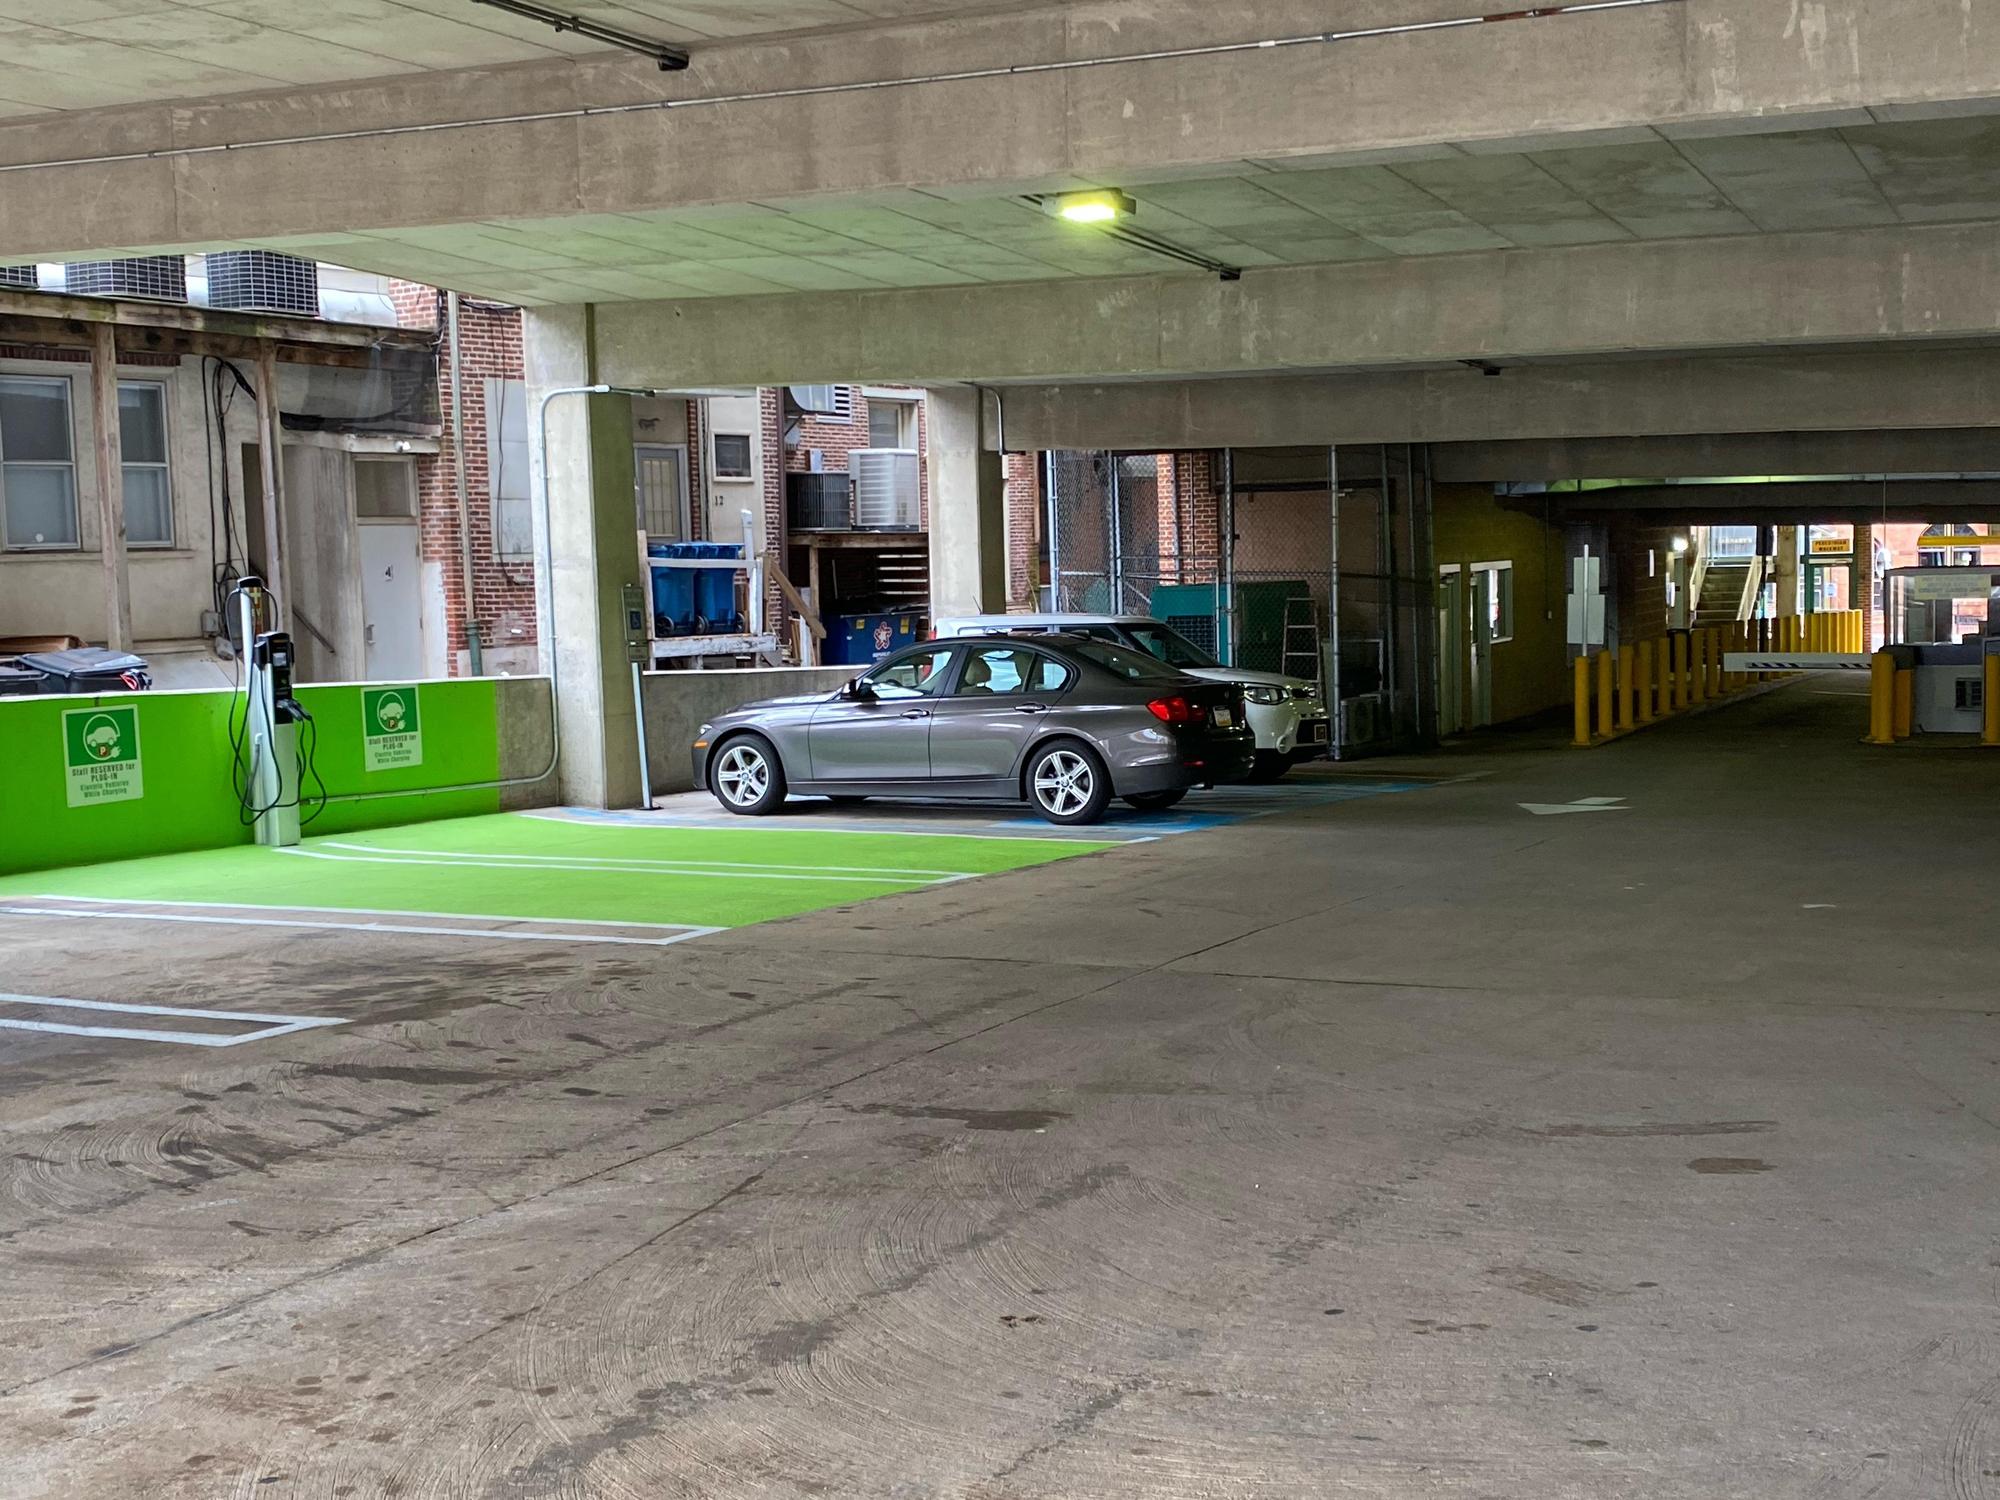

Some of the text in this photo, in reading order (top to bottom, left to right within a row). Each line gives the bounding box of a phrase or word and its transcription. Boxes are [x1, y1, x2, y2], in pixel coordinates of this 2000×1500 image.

[100, 746, 106, 756] P
[90, 764, 124, 774] RESERVED
[90, 772, 118, 782] PLUG-IN
